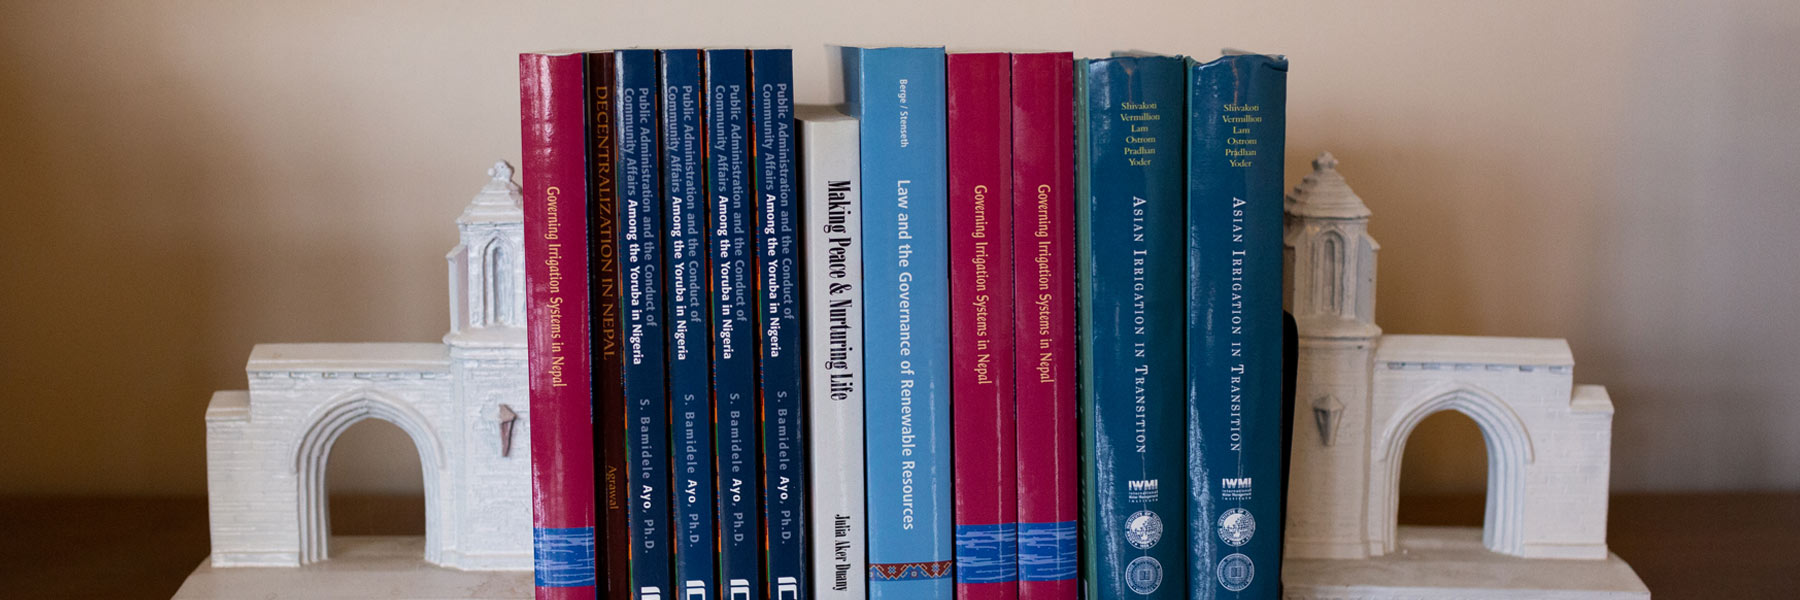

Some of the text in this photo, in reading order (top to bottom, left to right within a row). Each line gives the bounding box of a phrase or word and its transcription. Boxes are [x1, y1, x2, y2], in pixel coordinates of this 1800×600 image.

[898, 79, 908, 104] Berge
[900, 111, 909, 148] Stenseth
[1120, 113, 1160, 122] Vermillion
[1121, 102, 1157, 111] Shivakoti
[1125, 136, 1156, 144] Ostrom
[1131, 125, 1149, 133] Lam
[1222, 115, 1262, 123] Vermillion
[1223, 104, 1260, 112] Shivakoti
[1227, 137, 1258, 145] Ostrom
[1233, 126, 1251, 134] Lam
[639, 88, 658, 327] Public Administration and the Conduct of
[682, 86, 702, 323] Public Administration and the Conduct of
[729, 85, 748, 322] Public Administration and the Conduct of
[777, 84, 795, 320] Public Administration and the Conduct of
[1124, 147, 1156, 156] Pradhan
[1129, 158, 1152, 167] Yoder
[1225, 148, 1257, 157] Pradhan
[1229, 160, 1252, 168] Yoder
[596, 86, 615, 361] DECENTRALIZATION IN NEPAL
[624, 88, 644, 366] Community Affairs Among the Yoruba in Nigeria
[668, 86, 688, 361] Community Affairs Among the Yoruba in Nigeria
[715, 85, 734, 360] Community Affairs Among the Yoruba in Nigeria
[763, 84, 781, 358] Community Affairs Among the Yoruba in Nigeria
[545, 187, 567, 388] Governing Irrigation Systems in Nepal
[824, 181, 853, 402] Making Peace & Nurturing Life
[973, 185, 993, 385] Governing Irrigation Systems in Nepal
[1035, 184, 1055, 384] Governing Irrigation Systems in Nepal
[897, 181, 916, 530] Law and the Governance of Renewable Resources
[607, 465, 619, 510] Agrawal
[639, 399, 655, 554] S. Bamidele Ayo, Ph.D.
[684, 394, 699, 548] S. Bamidele Ayo, Ph.D.
[729, 393, 744, 547] S. Bamidele Ayo, Ph.D.
[777, 391, 792, 545] S. Bamidele Ayo, Ph.D.
[1128, 479, 1159, 491] IWMI
[1222, 477, 1252, 489] IWMI
[832, 514, 851, 592] Julia Aker Duany
